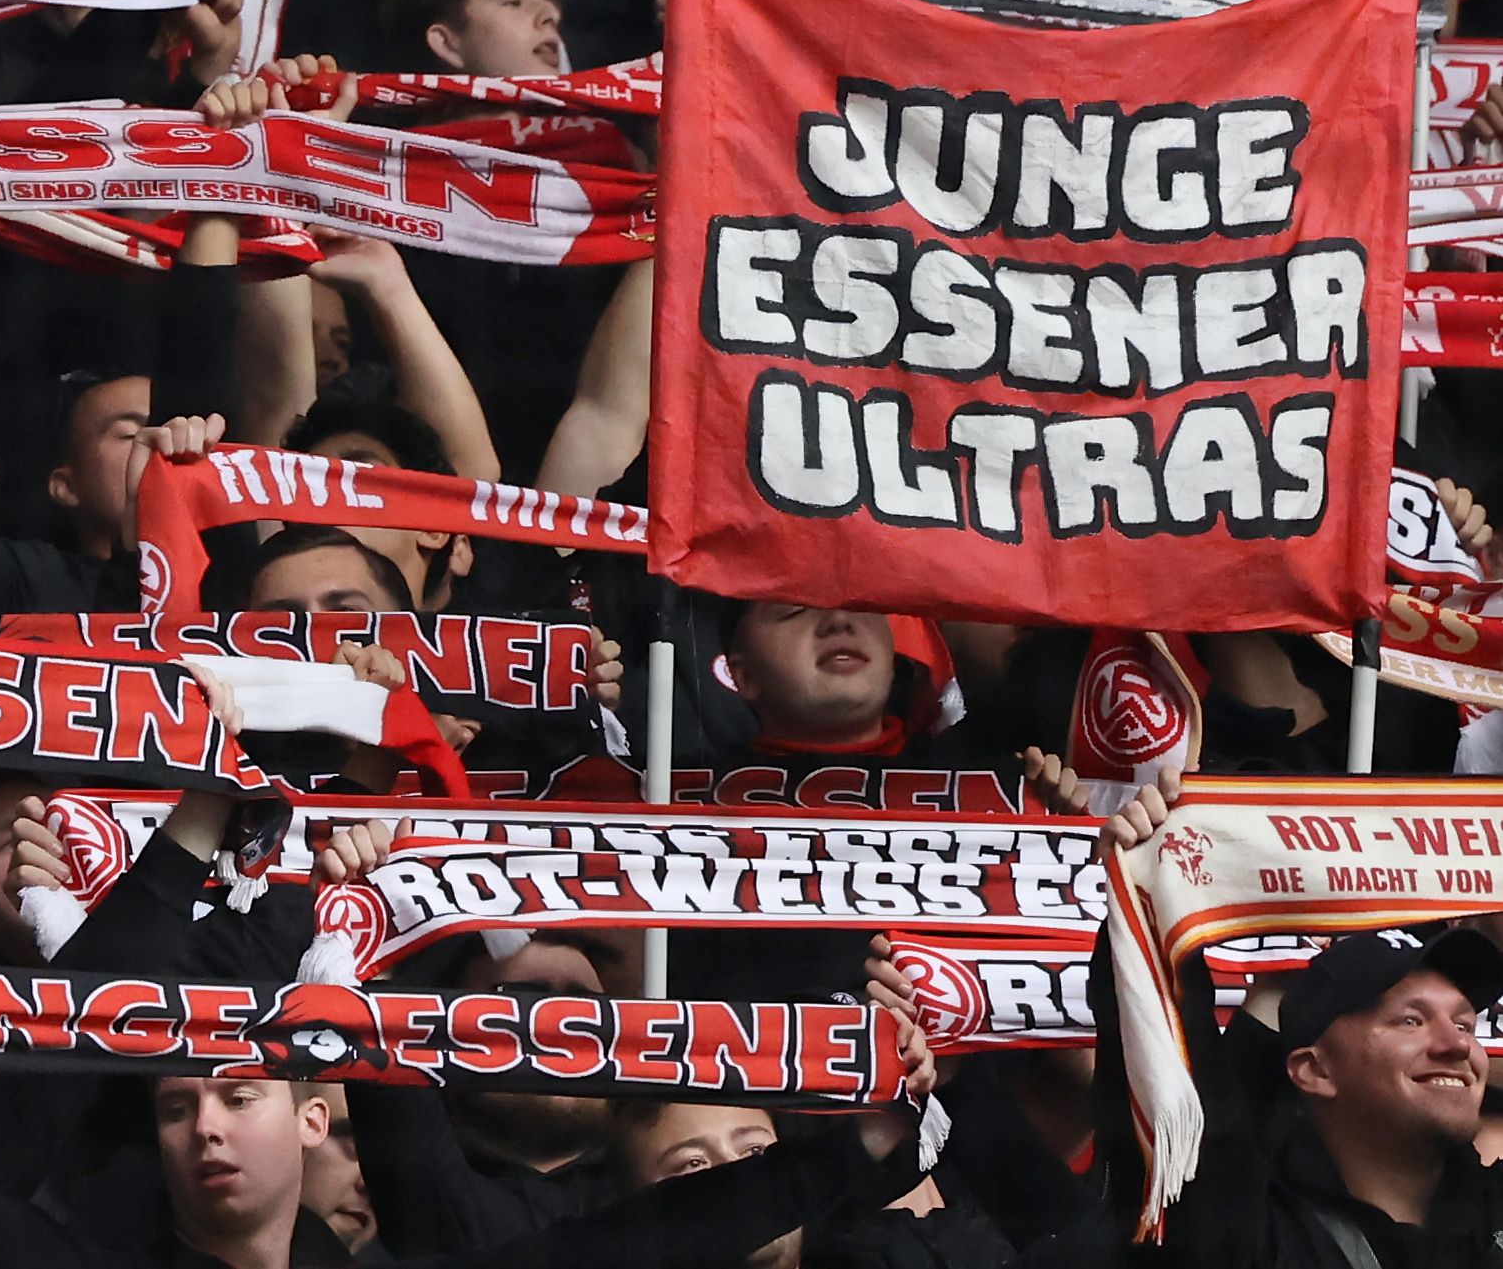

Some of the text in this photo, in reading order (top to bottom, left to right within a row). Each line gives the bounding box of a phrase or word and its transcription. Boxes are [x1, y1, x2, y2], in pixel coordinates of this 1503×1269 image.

[11, 182, 96, 202] SIND
[104, 178, 176, 201] ALLE
[185, 181, 321, 212] ESSENER
[324, 198, 444, 241] JUNGS
[807, 90, 1299, 233] JUNGE
[713, 225, 1369, 390] ESSENER
[759, 382, 1333, 533] ULTRAS
[368, 850, 986, 933] ROT-WEISS
[1259, 866, 1493, 894] DIE MACHT VON
